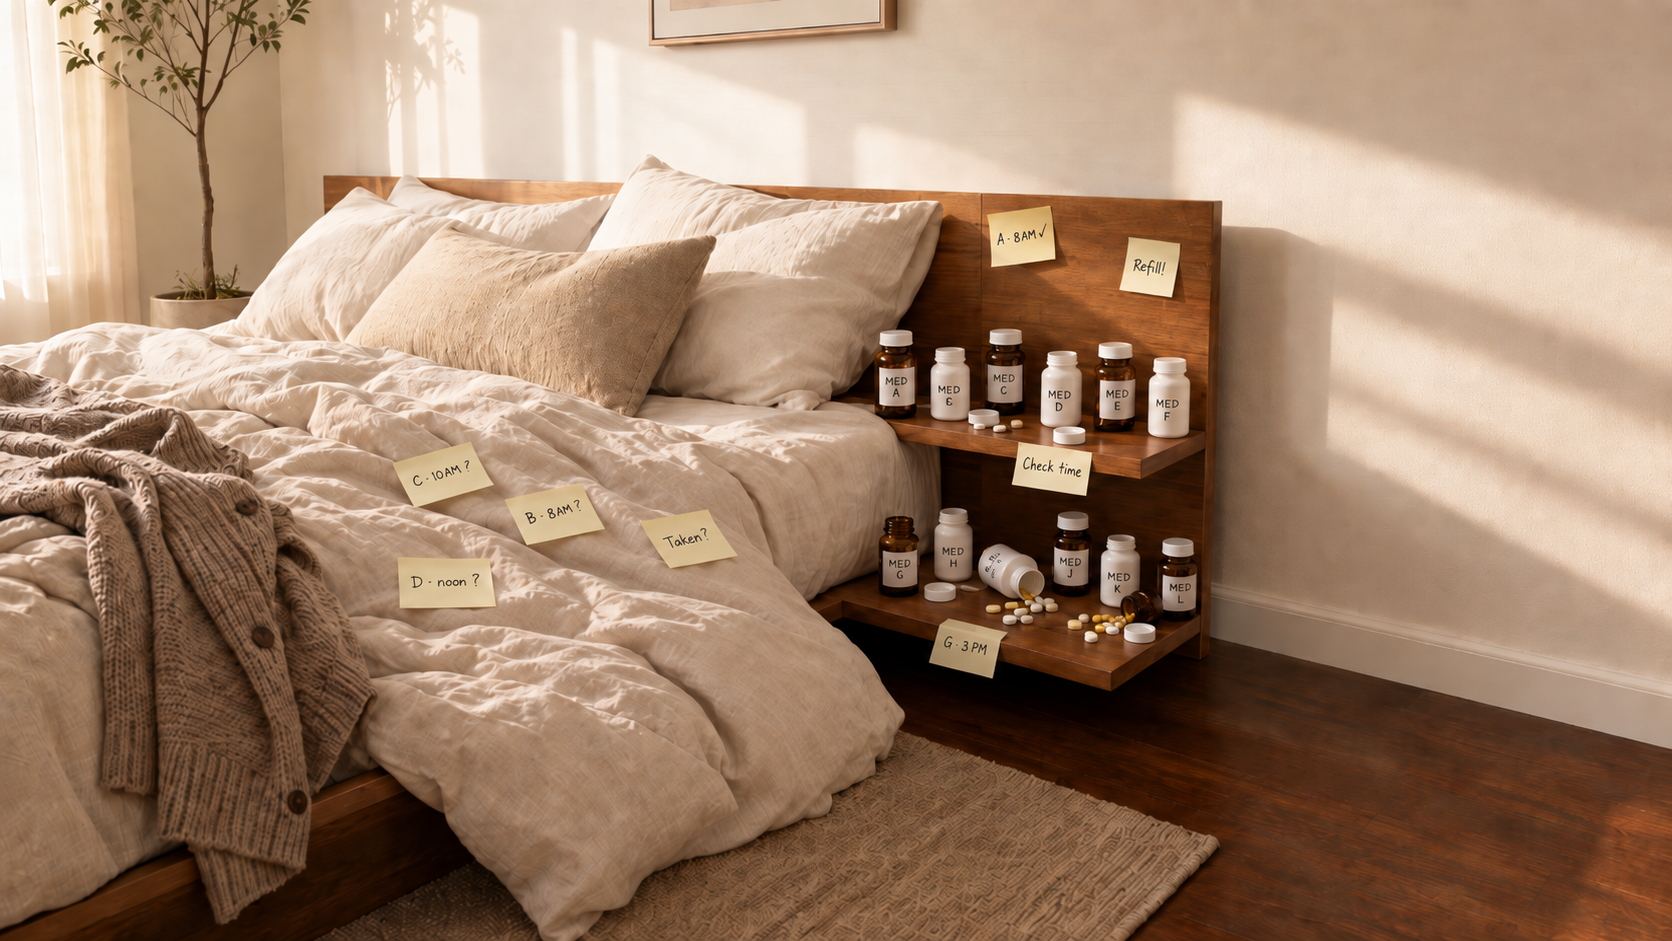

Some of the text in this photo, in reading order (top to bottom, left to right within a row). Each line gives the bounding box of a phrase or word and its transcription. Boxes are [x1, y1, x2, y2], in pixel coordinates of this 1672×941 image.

[1132, 258, 1167, 276] Refill!
[885, 376, 908, 387] MED
[993, 373, 1016, 383] MED
[892, 387, 901, 398] A
[938, 385, 961, 395] MED
[1000, 385, 1008, 396] C
[1048, 389, 1072, 400] MED
[1105, 389, 1130, 399] MED
[1055, 401, 1064, 412] D
[1114, 401, 1121, 411] E
[1155, 398, 1180, 409] MED
[1163, 411, 1171, 422] F
[1022, 456, 1082, 478] Check time
[662, 527, 709, 549] Taken?
[942, 546, 965, 556] MED
[888, 559, 911, 569] MED
[949, 559, 958, 568] H
[1059, 557, 1082, 567] MED
[896, 569, 904, 580] G
[1066, 568, 1074, 579] J
[1107, 571, 1132, 582] MED
[437, 579, 467, 587] noon
[1169, 582, 1192, 593] MED
[1114, 584, 1122, 594] K
[1177, 594, 1185, 604] L
